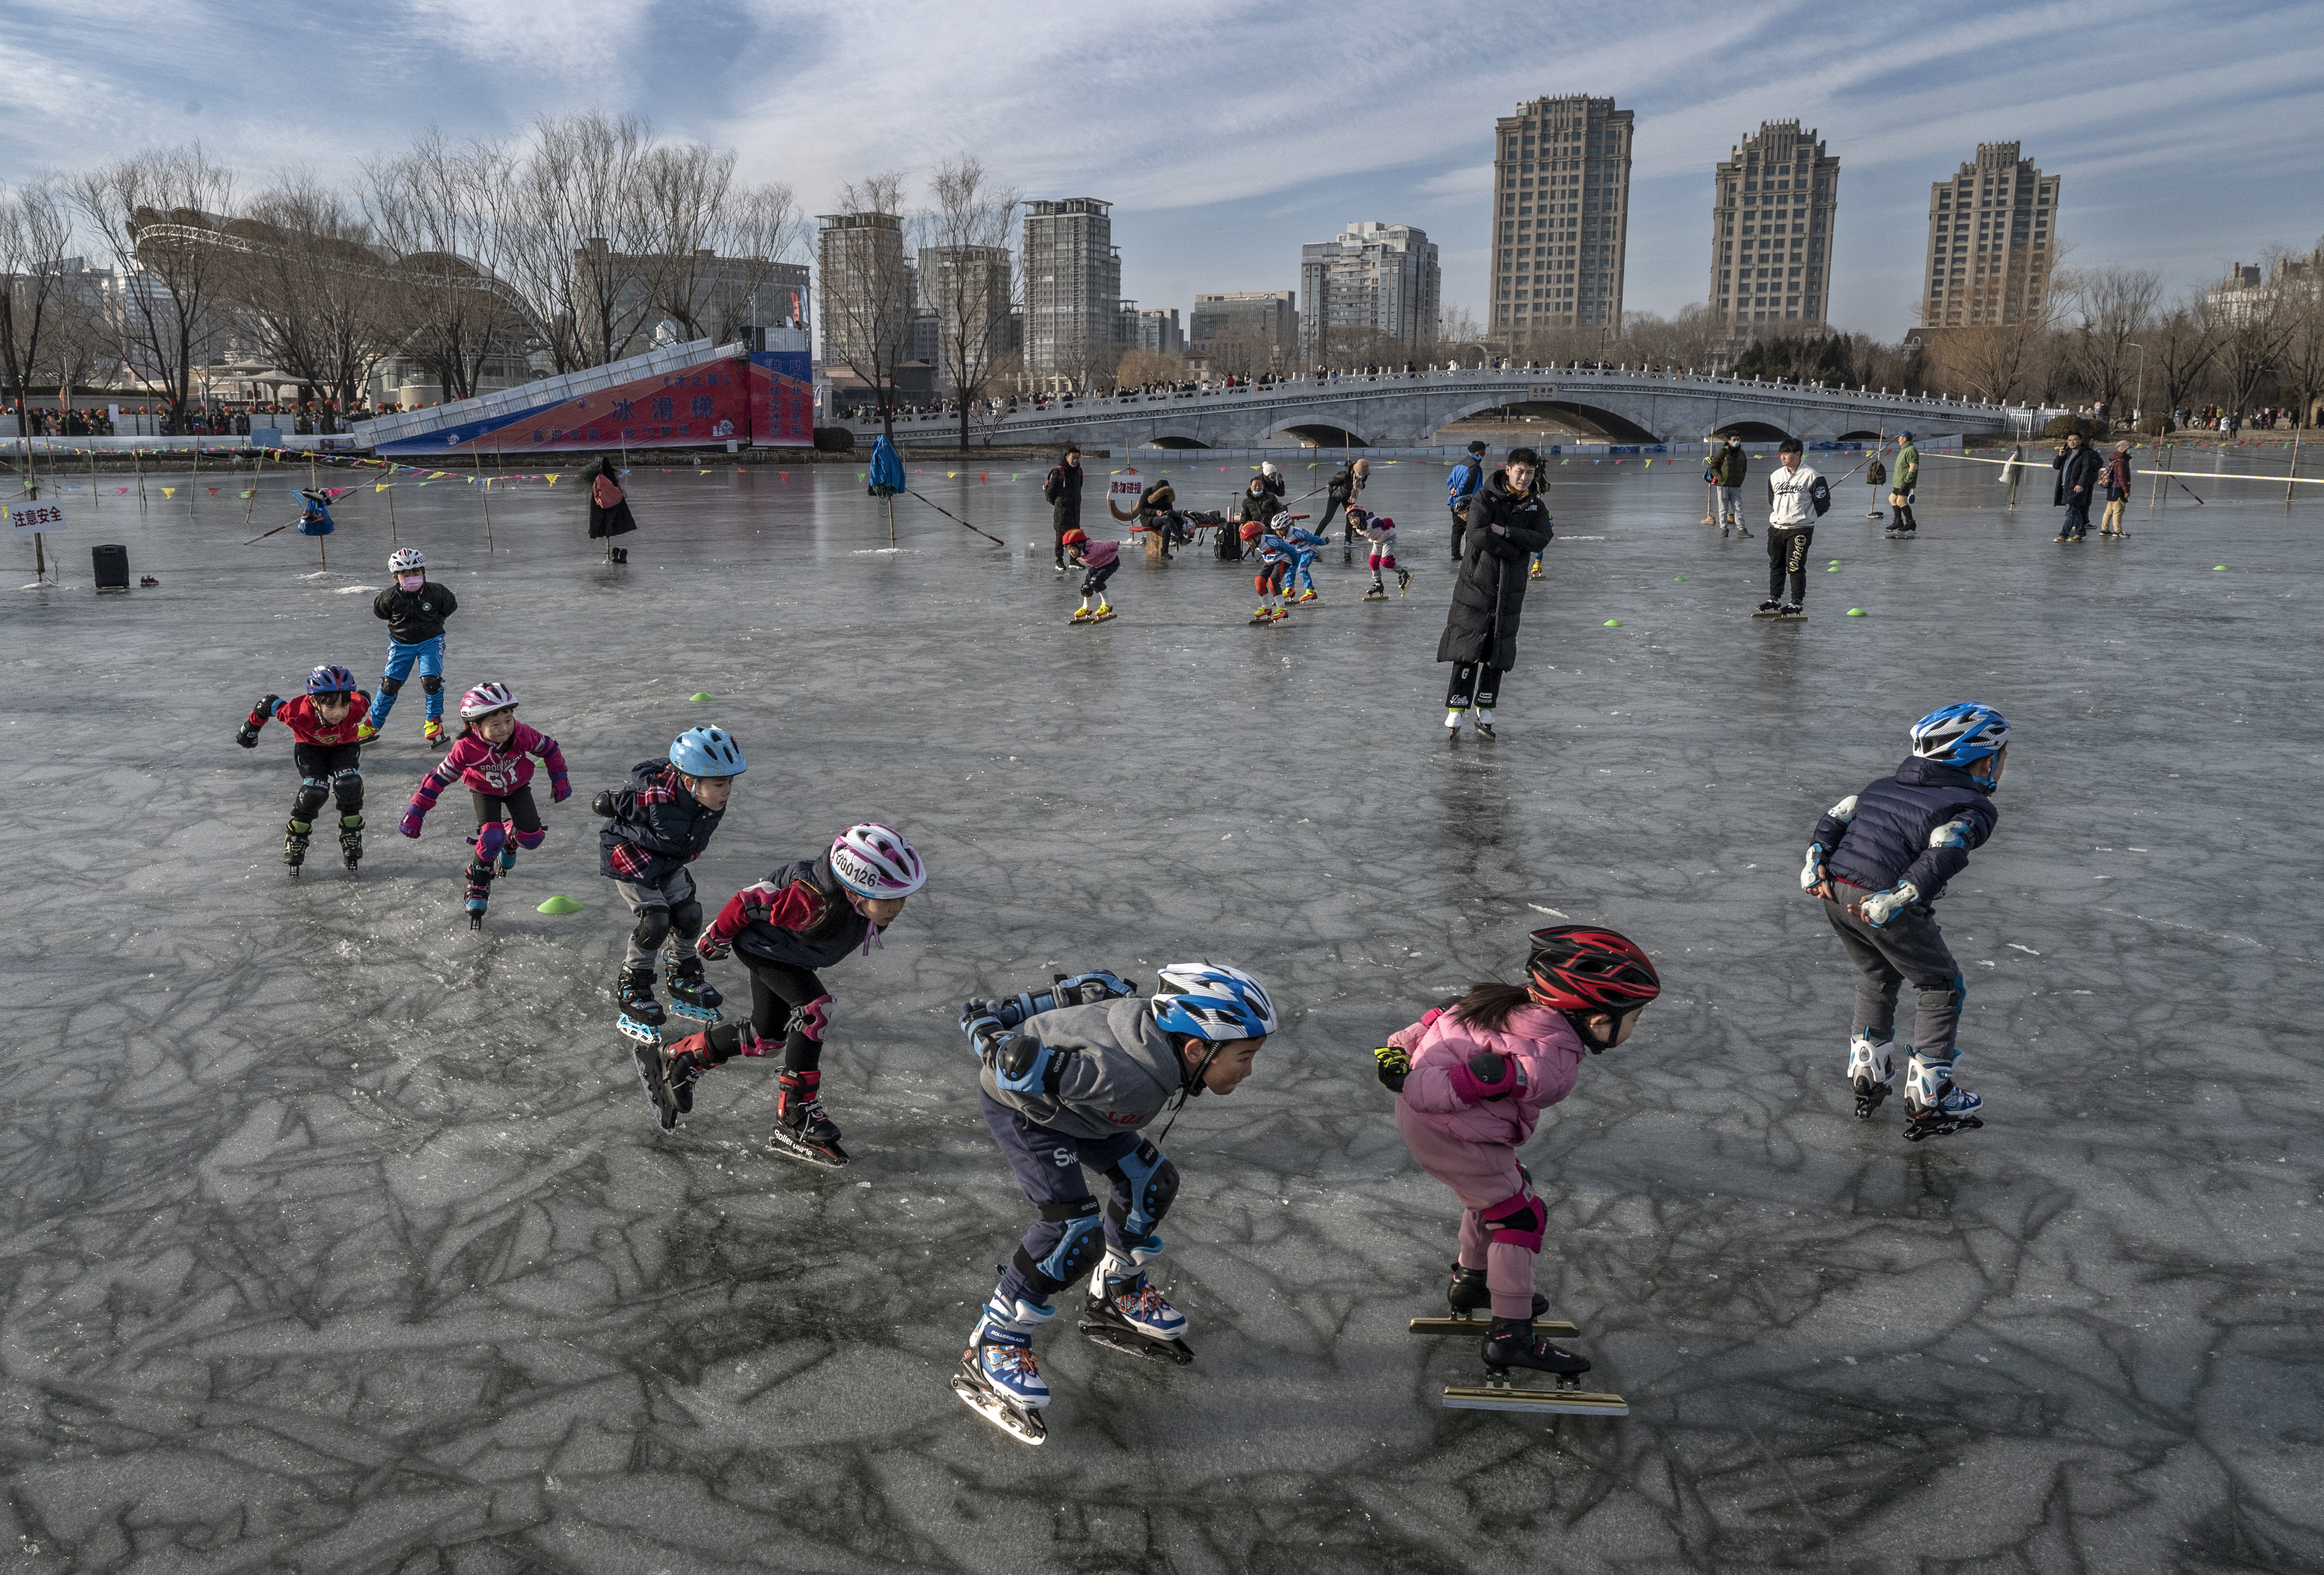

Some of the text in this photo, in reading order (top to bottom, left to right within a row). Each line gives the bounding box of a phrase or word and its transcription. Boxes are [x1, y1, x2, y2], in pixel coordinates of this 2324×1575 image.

[612, 395, 713, 421] 冰滑梯
[769, 360, 782, 435] 共享快乐冰雪
[790, 360, 802, 435] 助力北京冬奥
[533, 424, 689, 441] 喜迎冬奥 放飞梦想
[1111, 481, 1141, 494] 请勿碰撞
[12, 506, 62, 527] 注意安全
[836, 854, 877, 887] 000126
[990, 1330, 1025, 1343] ROLLERBLADE
